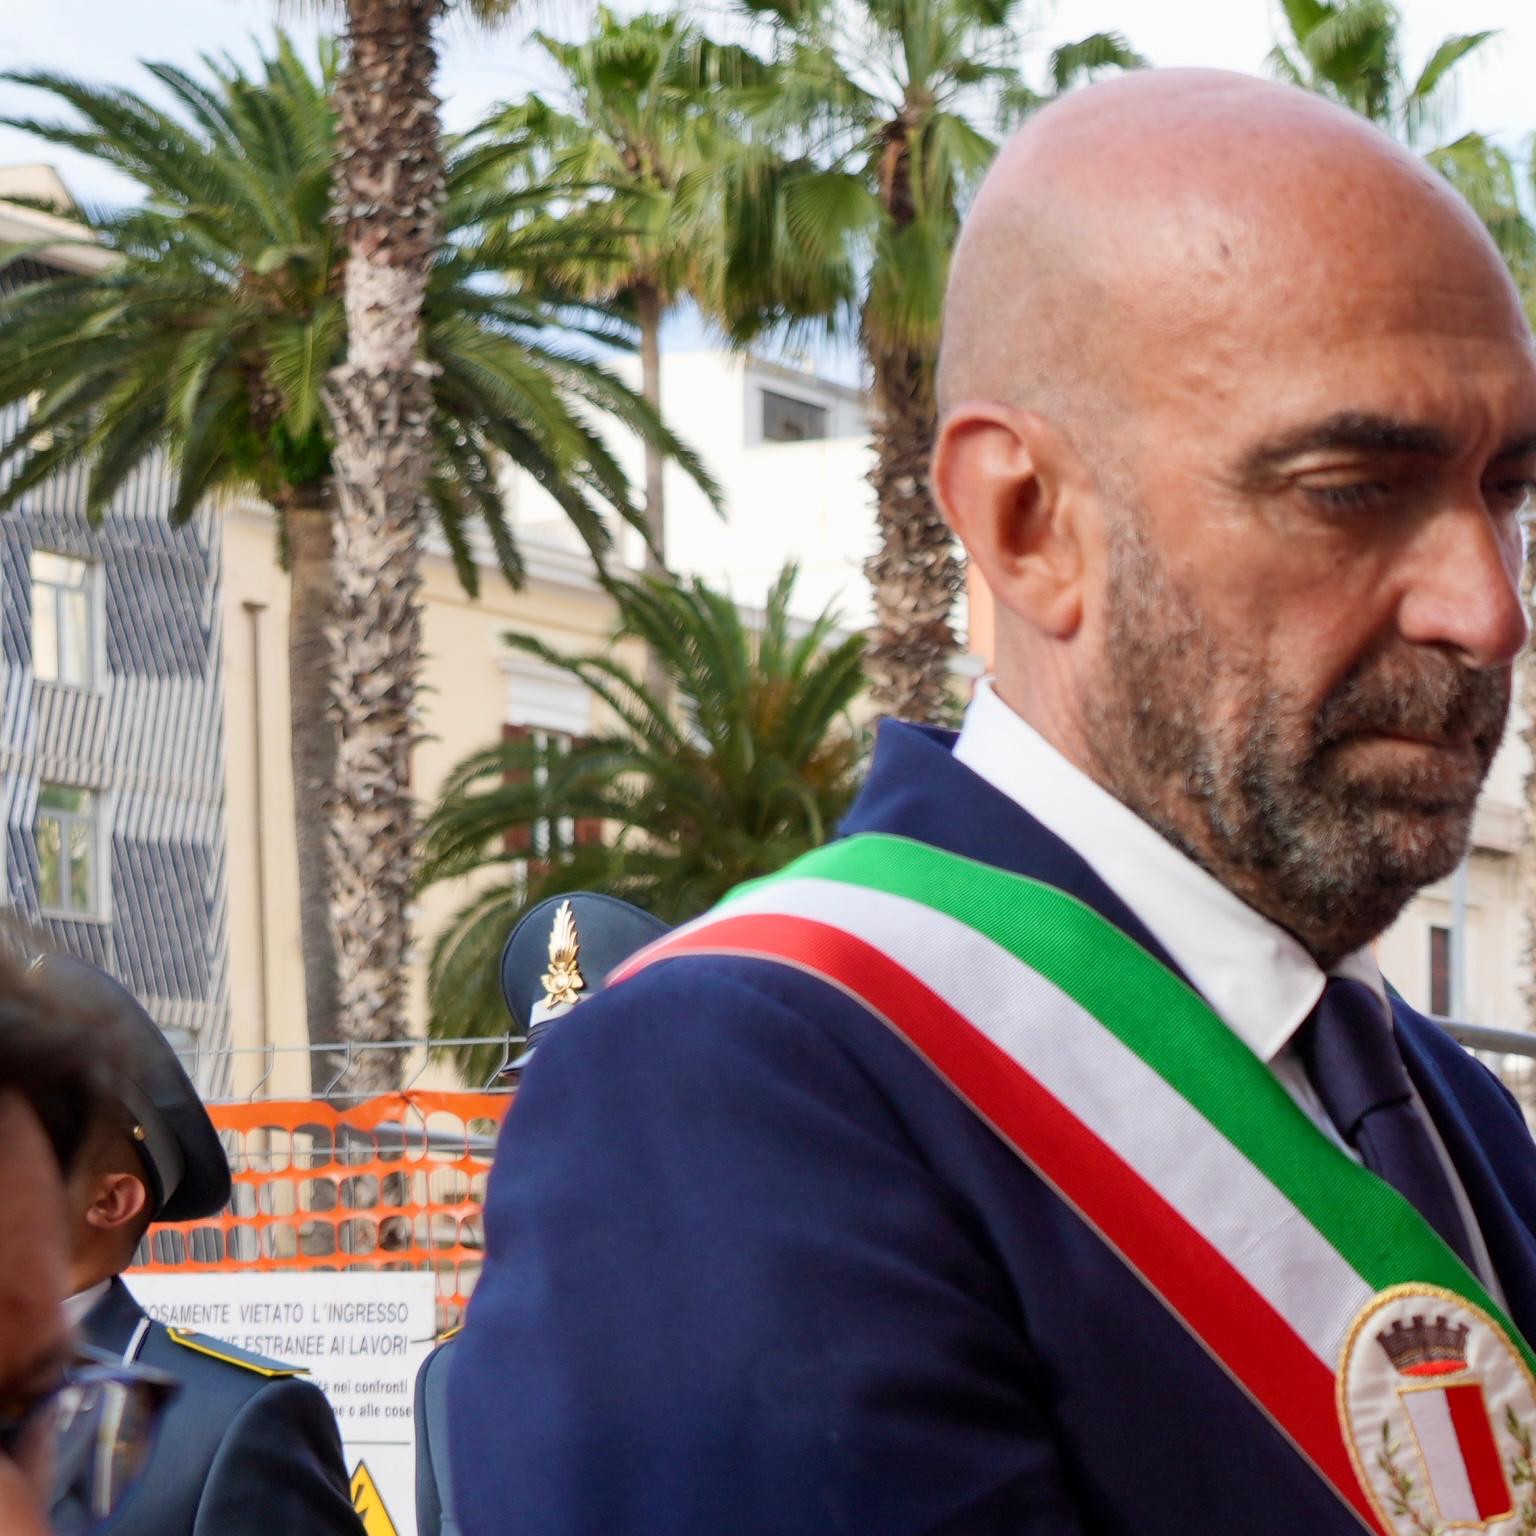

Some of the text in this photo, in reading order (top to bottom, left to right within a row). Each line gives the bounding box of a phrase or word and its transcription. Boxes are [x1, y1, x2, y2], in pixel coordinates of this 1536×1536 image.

[144, 1303, 409, 1324] OSAMENTE VIETATO L'INGRESSO
[245, 1336, 325, 1356] ESTRANEE
[331, 1336, 345, 1356] AI
[350, 1336, 408, 1356] LAVORI
[333, 1379, 351, 1394] nei
[355, 1378, 408, 1394] confronti
[349, 1405, 356, 1417] o
[360, 1402, 380, 1417] alle
[385, 1405, 413, 1418] cose
